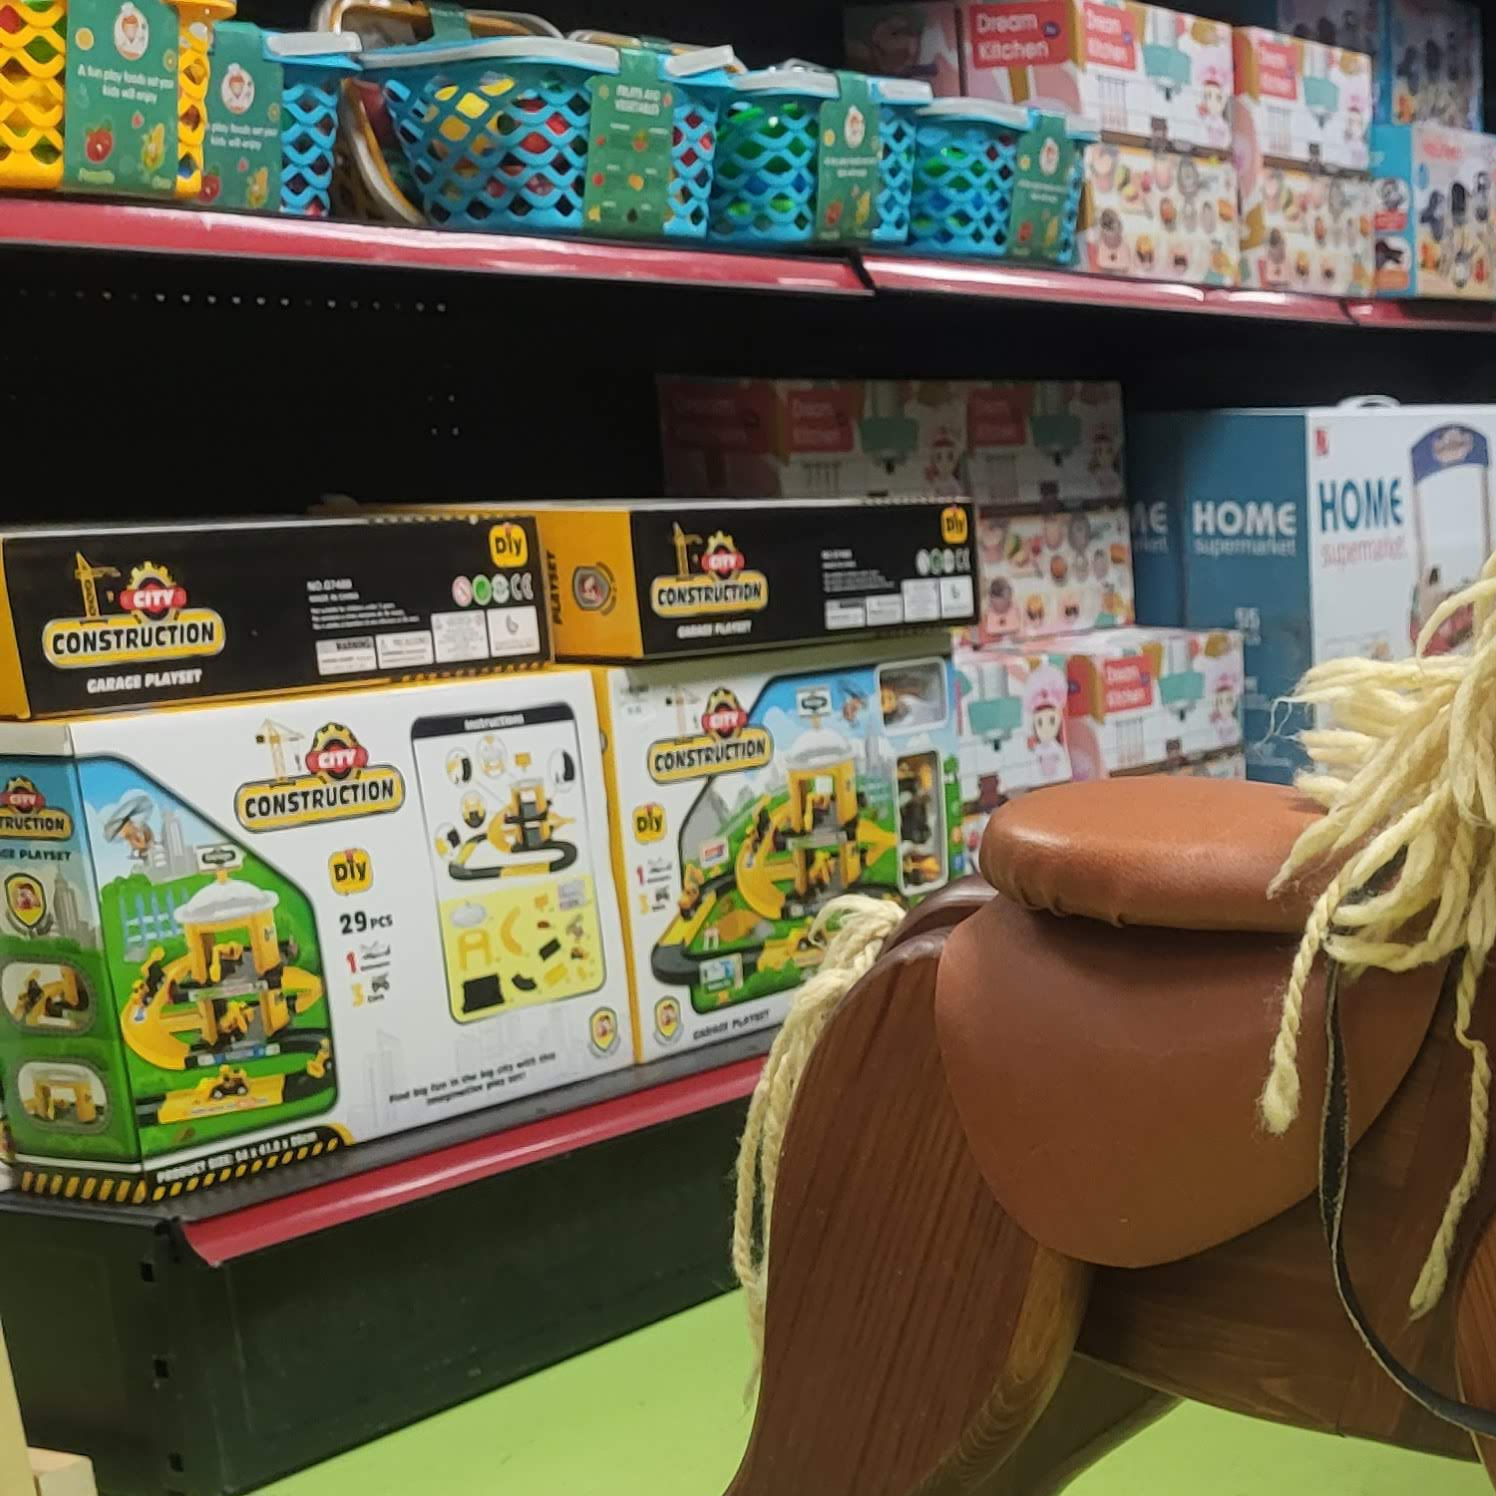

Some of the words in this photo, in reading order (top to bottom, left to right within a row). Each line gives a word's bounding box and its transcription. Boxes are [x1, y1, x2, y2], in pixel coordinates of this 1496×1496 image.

[977, 13, 1038, 34] Dream
[1191, 500, 1299, 536] HOME
[1318, 480, 1405, 532] HOME
[1192, 536, 1298, 559] supermarket
[133, 589, 175, 608] CITY
[657, 581, 763, 606] CONSTRUCTION
[52, 621, 214, 655] CONSTRUCTION
[86, 675, 142, 694] GARAGE
[144, 668, 203, 688] PLAYSET
[318, 748, 356, 769] CITY
[654, 738, 766, 772] CONSTRUCTION
[245, 778, 395, 818] CONSTRUCTION
[339, 911, 368, 935] 29
[370, 914, 393, 930] PCS
